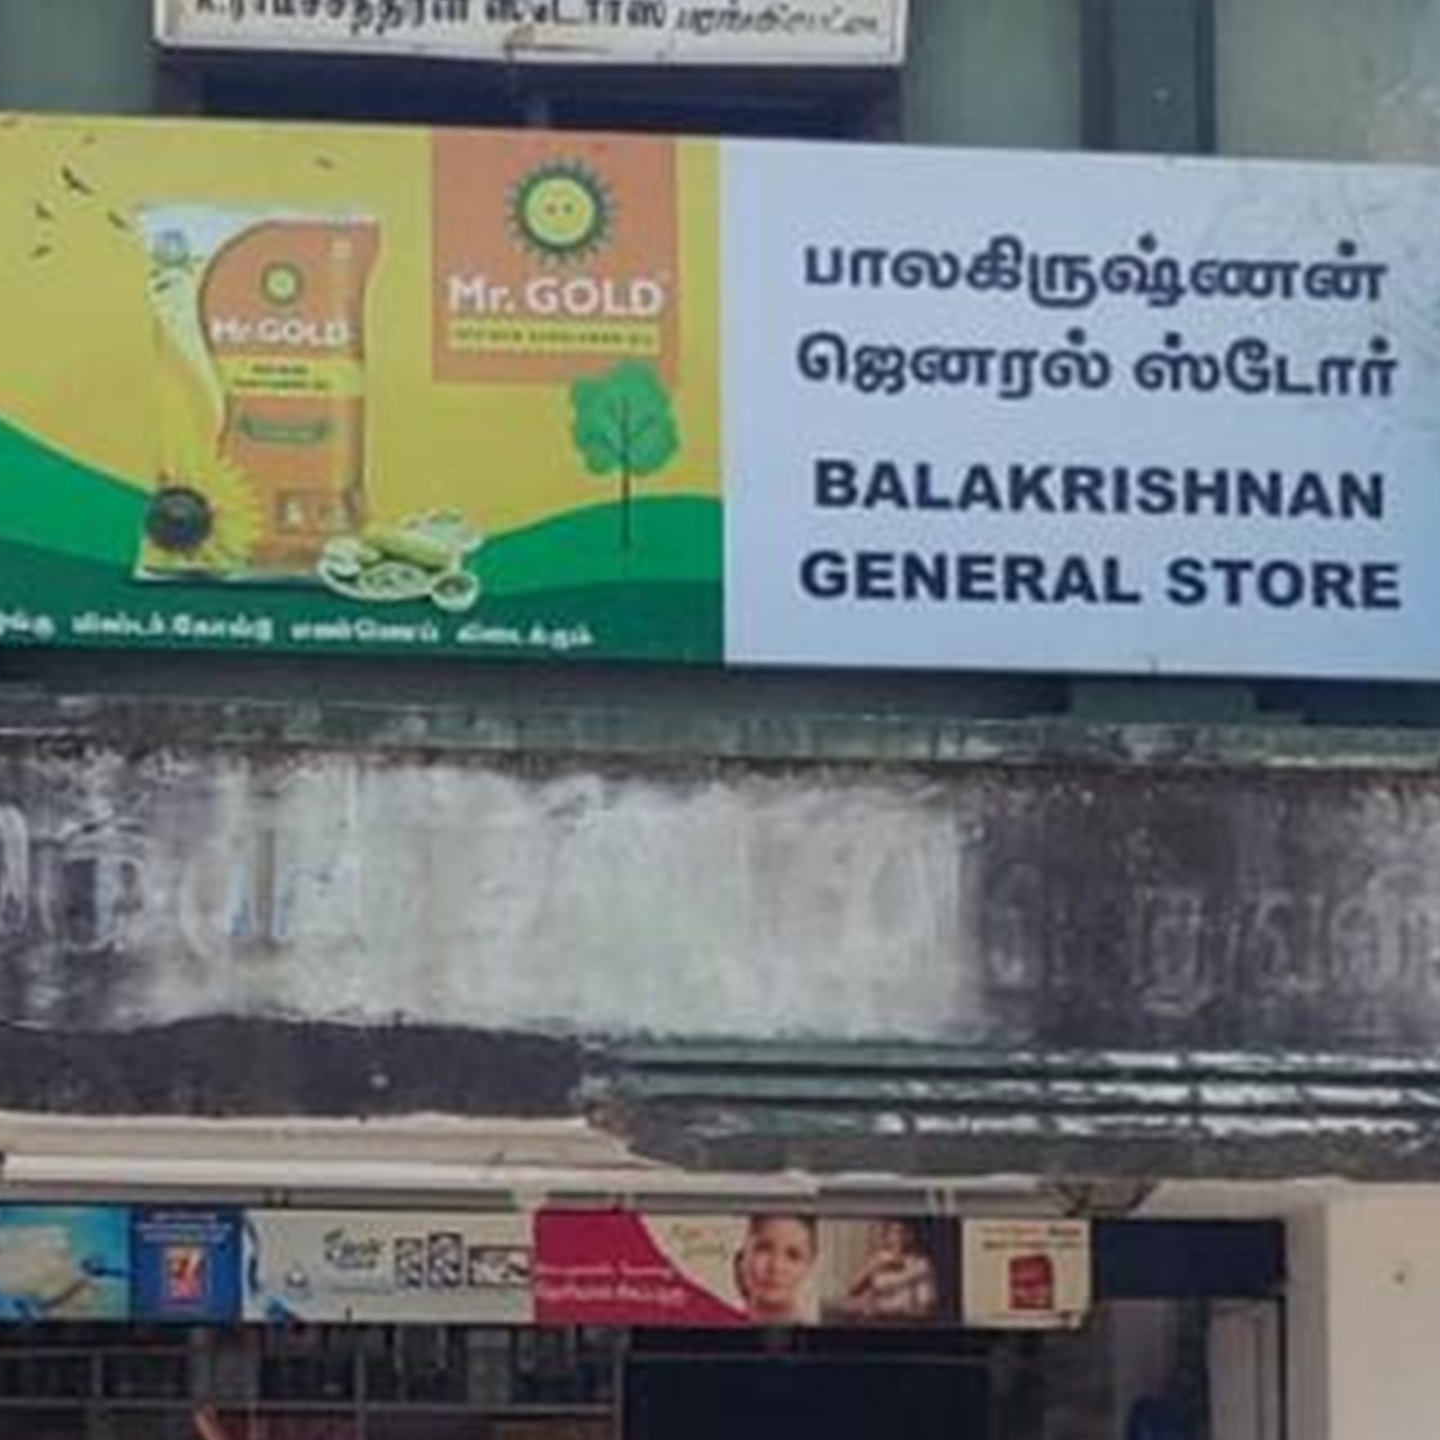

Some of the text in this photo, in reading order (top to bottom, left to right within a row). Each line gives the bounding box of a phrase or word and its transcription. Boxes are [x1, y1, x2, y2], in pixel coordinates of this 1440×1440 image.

[448, 276, 665, 317] Mr. GOLD
[804, 232, 1391, 310] பாலகிருஷ்ணன்
[796, 327, 1400, 401] ஜெனரல் ஸ்டோர்
[814, 458, 1385, 521] BALAKRISHNAN
[799, 549, 1403, 611] GENERAL STORE
